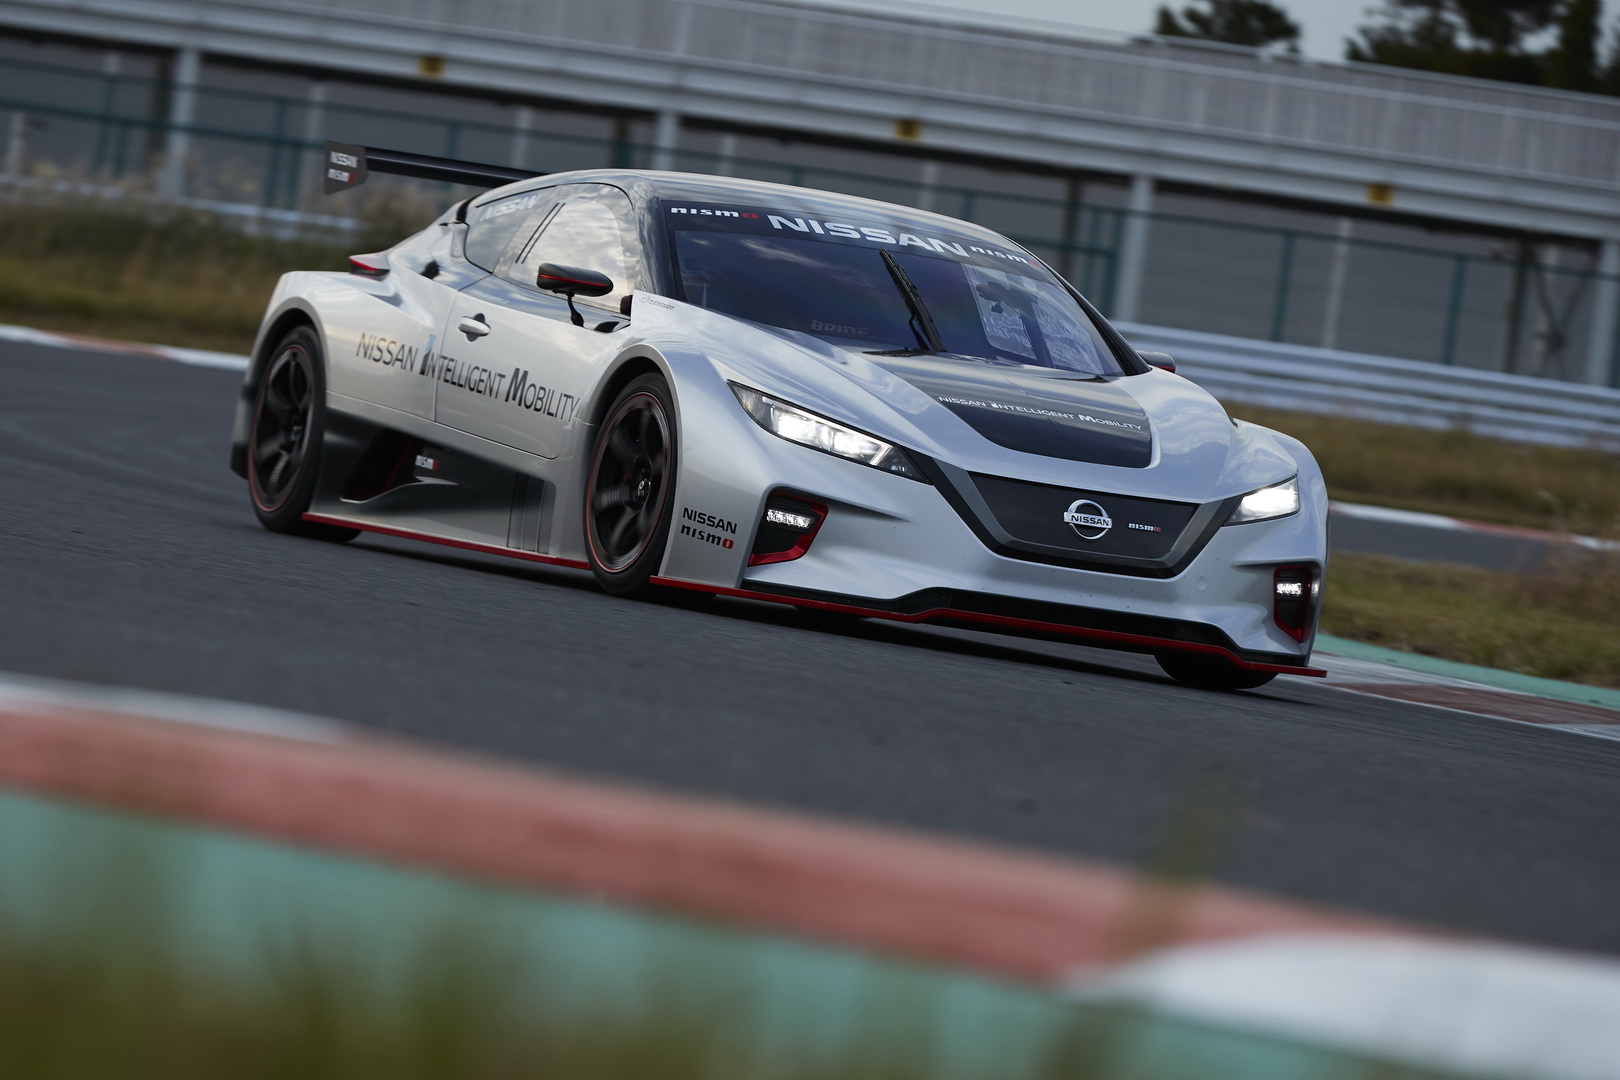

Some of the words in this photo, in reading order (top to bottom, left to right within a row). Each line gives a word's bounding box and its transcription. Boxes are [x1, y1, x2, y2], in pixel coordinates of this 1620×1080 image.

[671, 207, 759, 219] nismo
[767, 215, 970, 257] NISSAN
[969, 245, 1044, 269] nismo
[355, 333, 419, 372] NISSAN
[418, 334, 506, 399] INTELLIGENT
[504, 367, 580, 422] MOBILITY
[938, 396, 987, 408] NISSAN
[990, 400, 1075, 420] INTELLIGENT
[1078, 414, 1142, 431] MOBILITY
[682, 507, 738, 535] NISSAN
[1070, 513, 1111, 527] NISSAN
[1128, 522, 1161, 533] nismo
[680, 524, 734, 550] nismo
